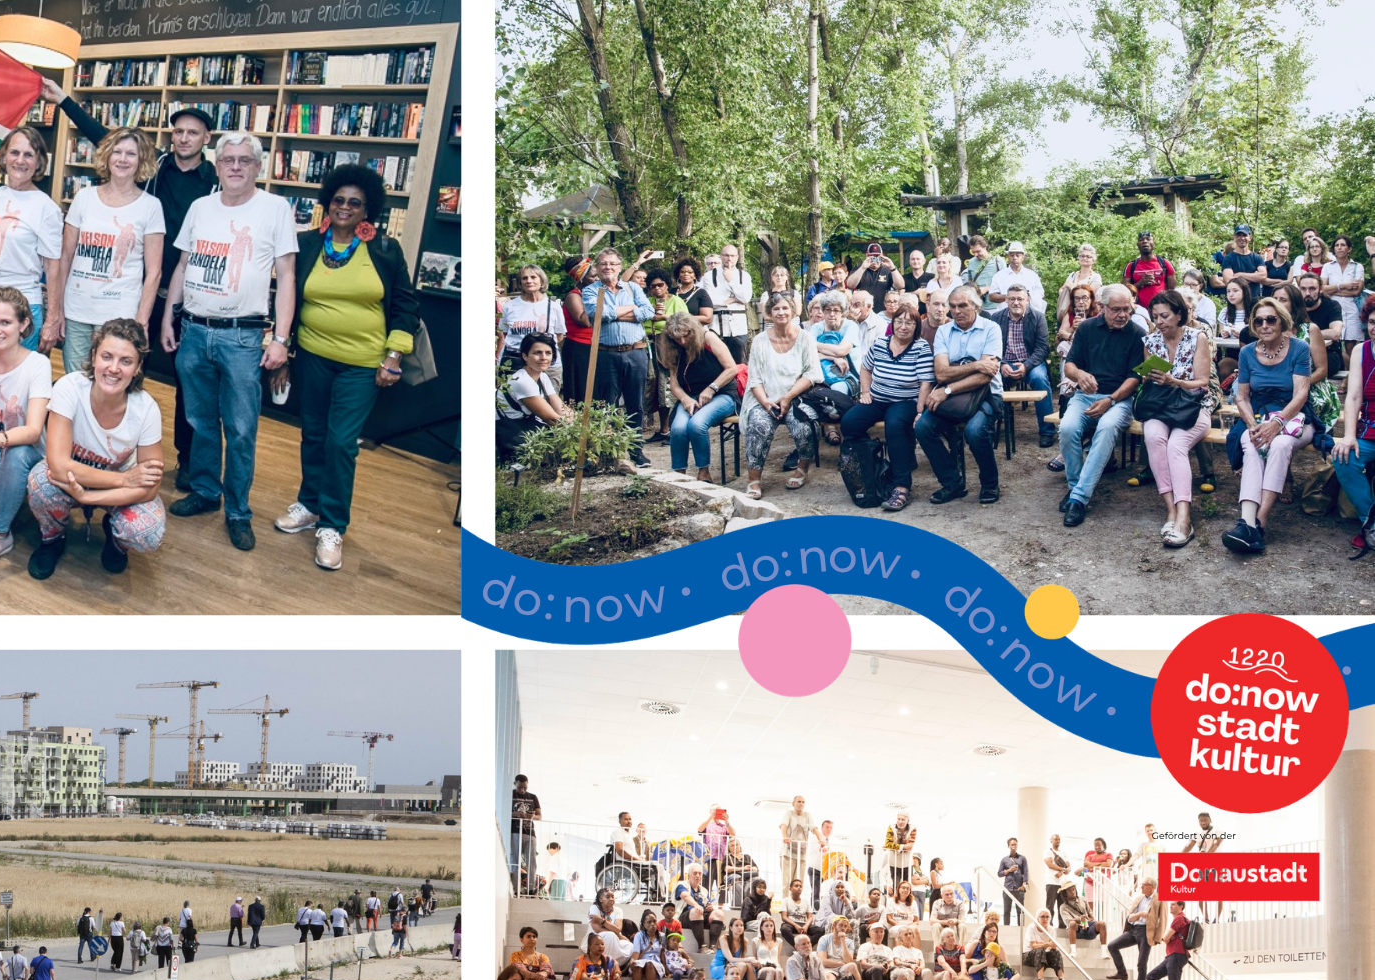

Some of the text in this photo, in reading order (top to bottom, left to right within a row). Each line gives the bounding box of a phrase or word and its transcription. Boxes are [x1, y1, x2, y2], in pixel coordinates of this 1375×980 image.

[147, 13, 183, 35] Krimis
[256, 4, 286, 28] Dann
[291, 7, 313, 24] war
[318, 0, 362, 22] endlich
[367, 0, 400, 18] alles
[80, 231, 116, 248] NELSON
[196, 239, 231, 257] NELSON
[1243, 951, 1327, 964] ZU DEN TOILETTEN
